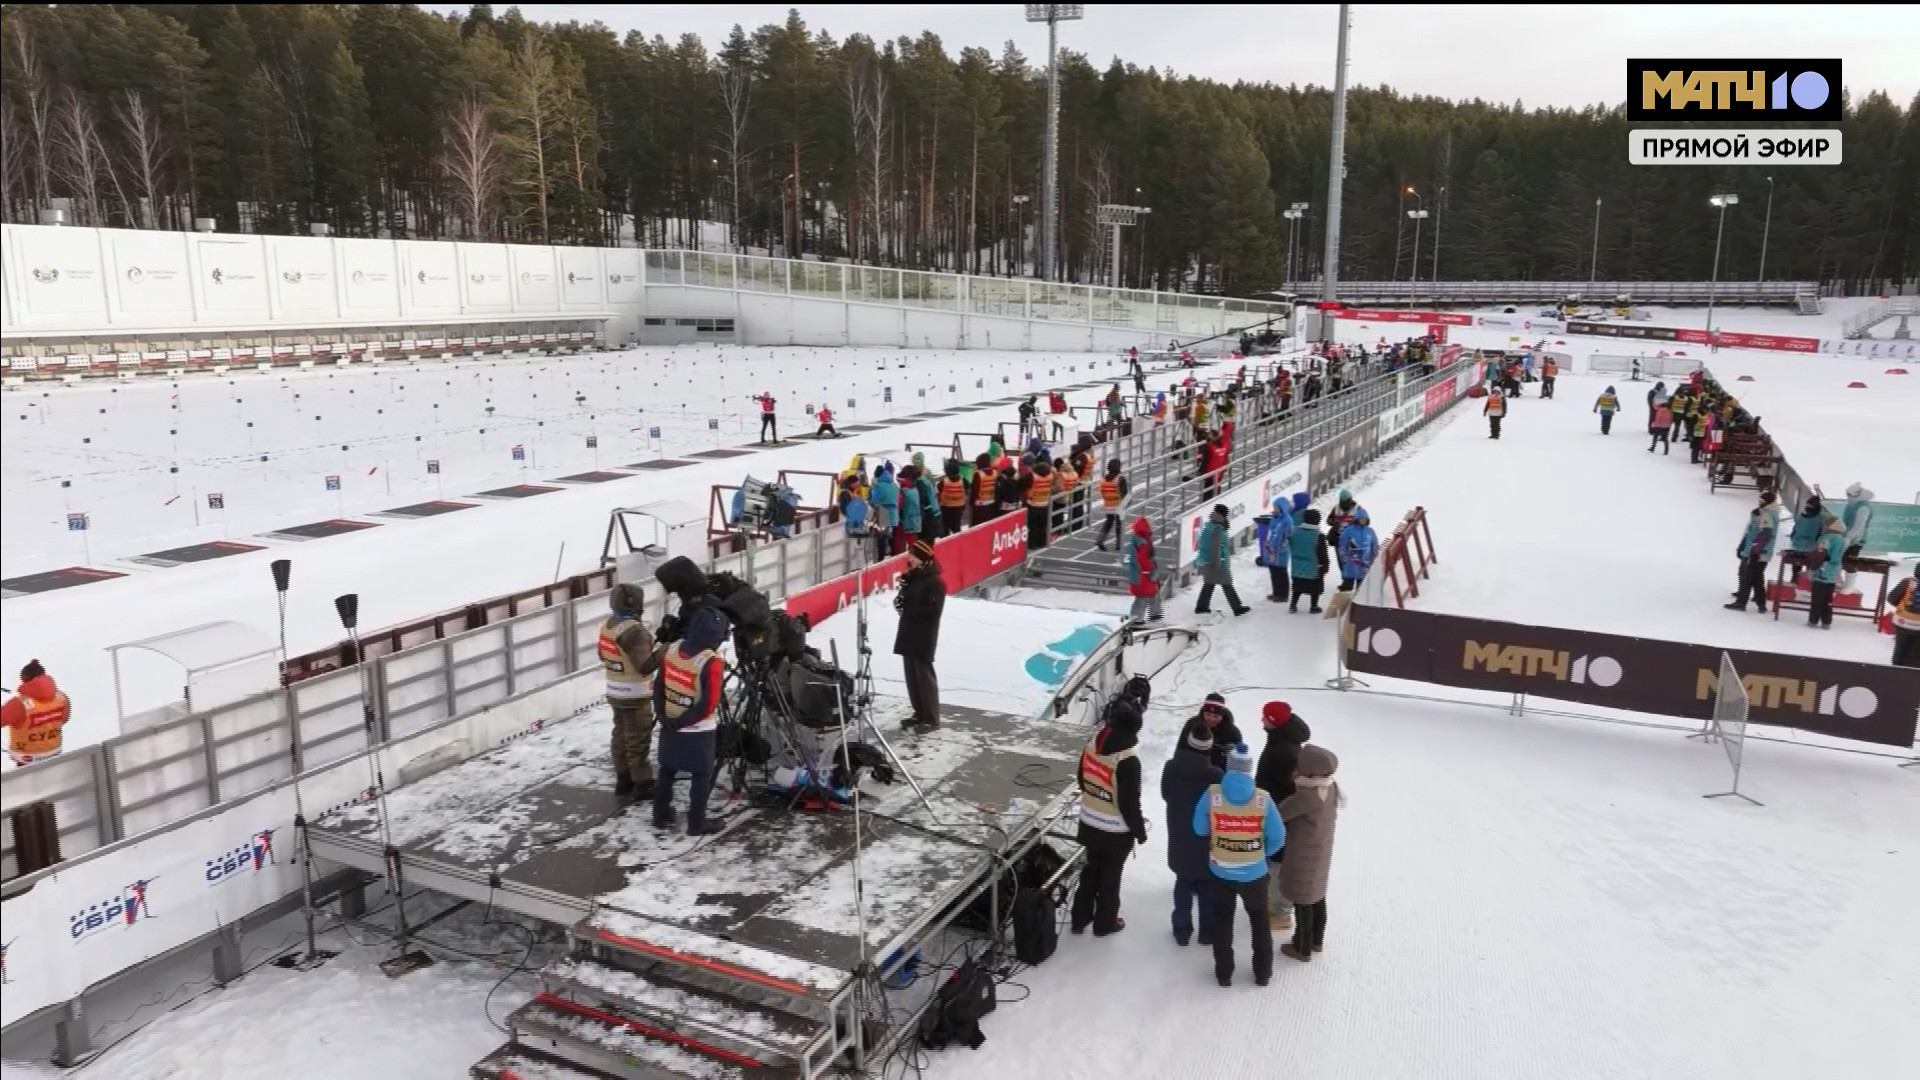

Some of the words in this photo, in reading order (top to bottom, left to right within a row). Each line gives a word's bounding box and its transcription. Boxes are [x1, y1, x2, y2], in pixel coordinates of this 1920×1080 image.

[992, 523, 1029, 555] Альфа
[205, 851, 252, 881] СБР
[70, 902, 123, 939] СБР
